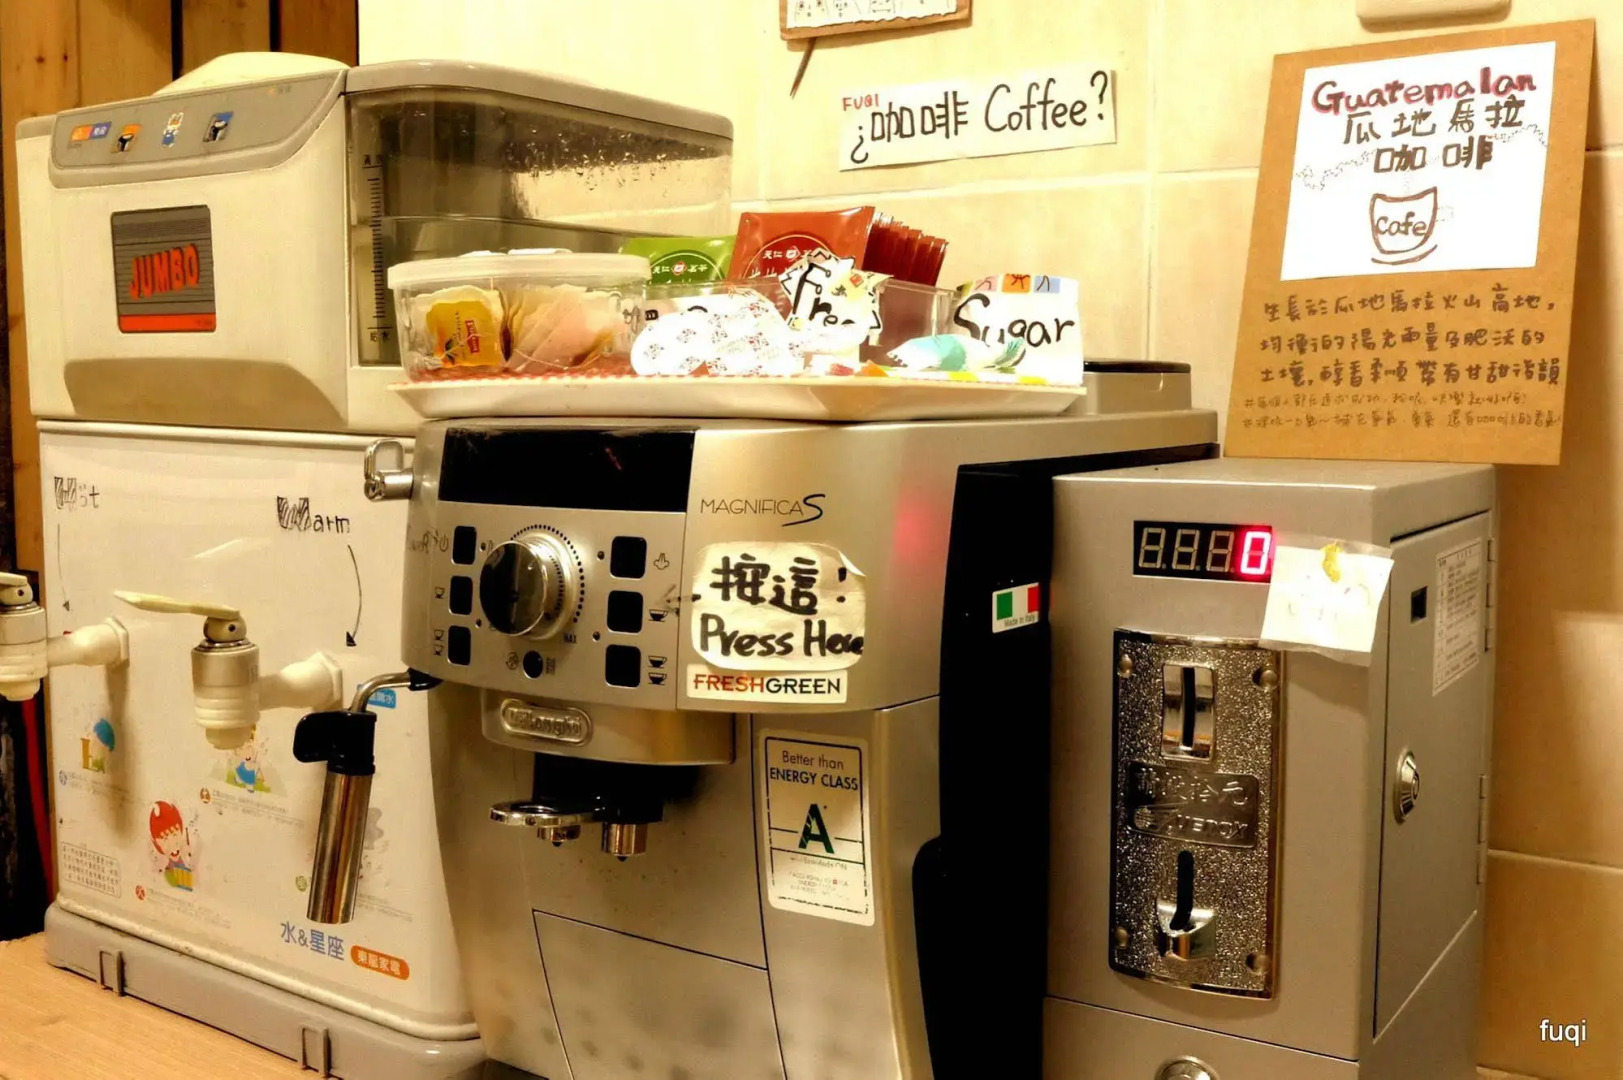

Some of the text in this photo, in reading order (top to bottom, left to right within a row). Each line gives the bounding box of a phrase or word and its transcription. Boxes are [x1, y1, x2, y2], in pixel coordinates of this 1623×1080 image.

[1311, 66, 1537, 117] Guatemalan
[1342, 93, 1526, 144] 瓜地馬拉
[1373, 134, 1493, 173] 咖啡
[130, 243, 200, 300] JUMBO
[700, 498, 804, 517] MAGNIFICA
[700, 613, 794, 657] Press
[693, 674, 841, 695] FRESHGREEN
[769, 768, 858, 791] ENERGY CLASS
[782, 751, 844, 770] Better than
[798, 803, 835, 854] A
[280, 921, 345, 961] 水&星座
